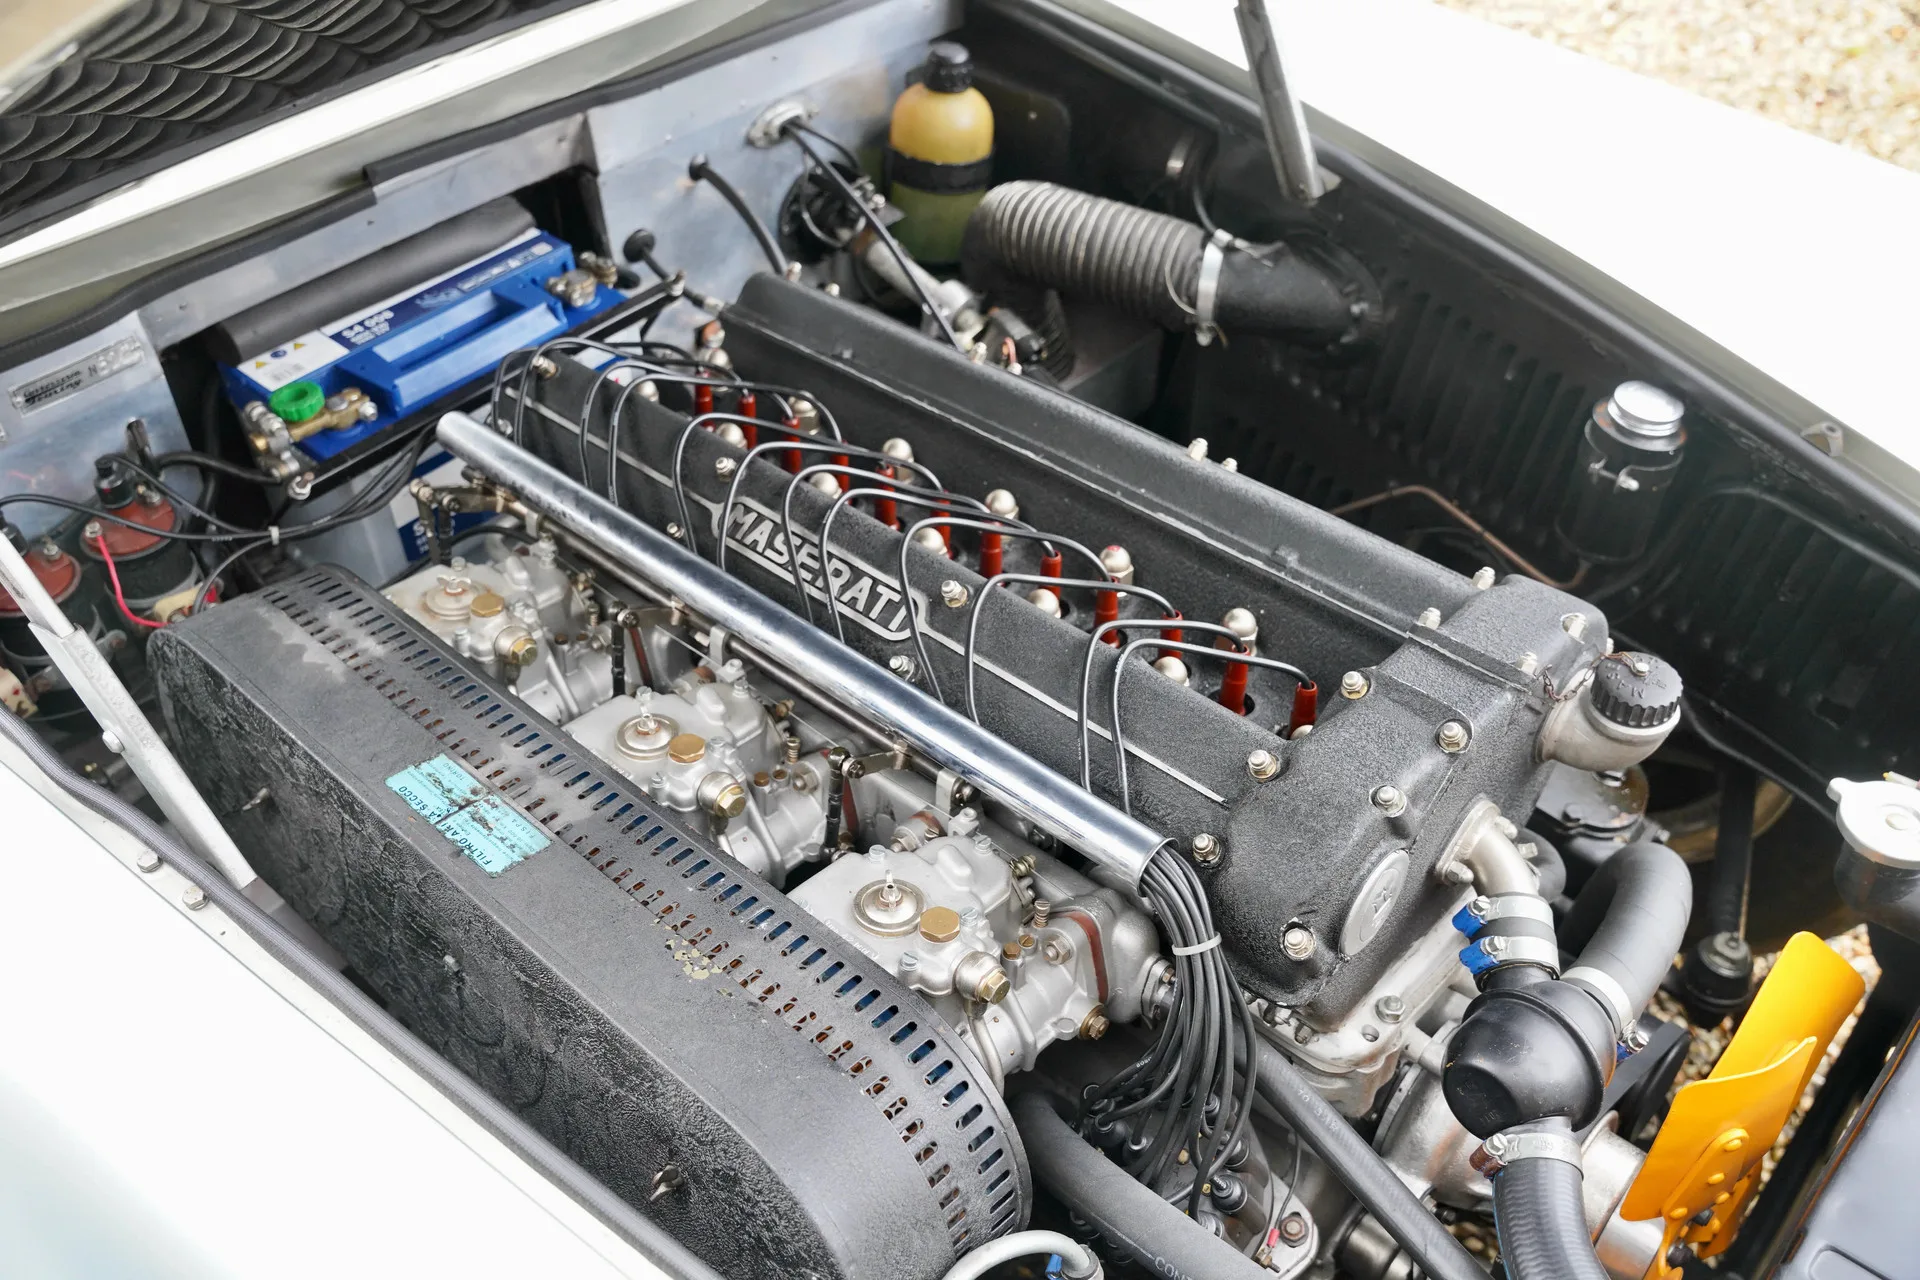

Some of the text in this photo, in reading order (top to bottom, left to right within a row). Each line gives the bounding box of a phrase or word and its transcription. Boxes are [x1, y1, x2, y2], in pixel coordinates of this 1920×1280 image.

[727, 503, 908, 632] MASERATI
[442, 762, 465, 781] TORINO
[398, 785, 428, 810] SECCO
[458, 836, 492, 865] FILTRO
